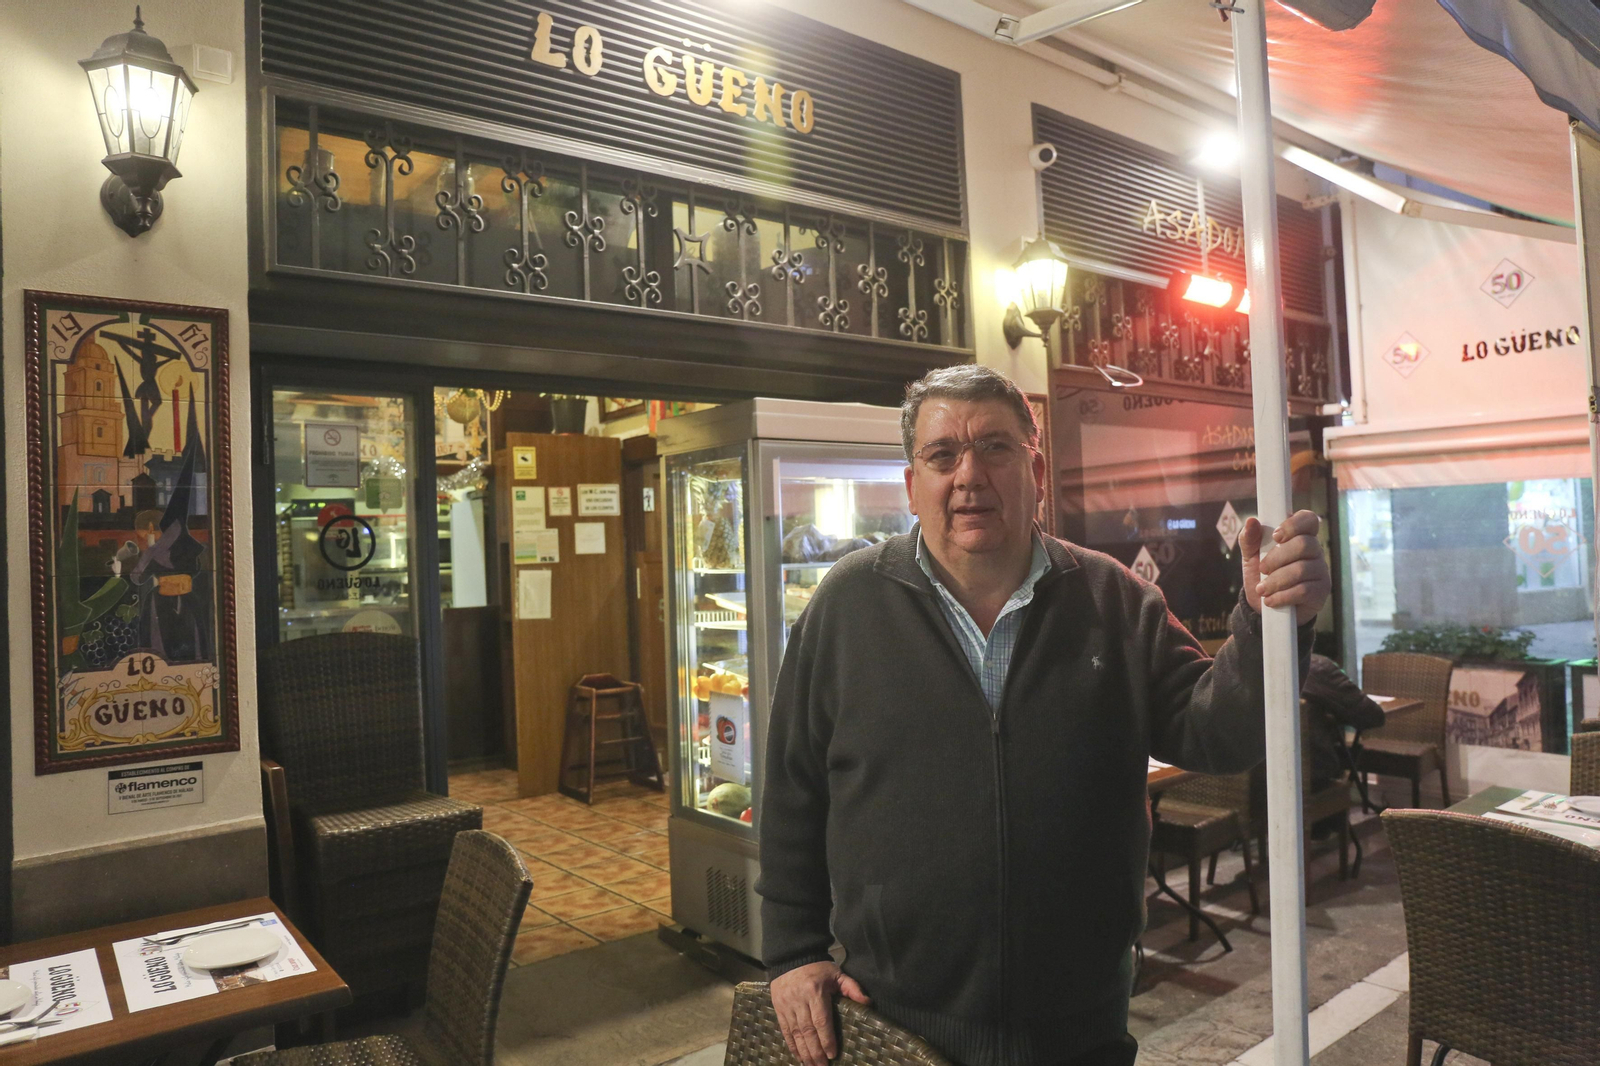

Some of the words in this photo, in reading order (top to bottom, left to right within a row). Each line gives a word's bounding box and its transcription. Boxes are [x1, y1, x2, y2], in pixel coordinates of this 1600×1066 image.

[531, 12, 603, 76] LO
[644, 38, 815, 134] GÜENO
[1491, 269, 1524, 294] 50
[1461, 341, 1488, 362] LO
[1494, 326, 1580, 356] GÜENO
[1222, 514, 1237, 535] 50
[127, 656, 155, 676] LO
[95, 698, 184, 726] GÜENO
[128, 777, 197, 792] flamenco
